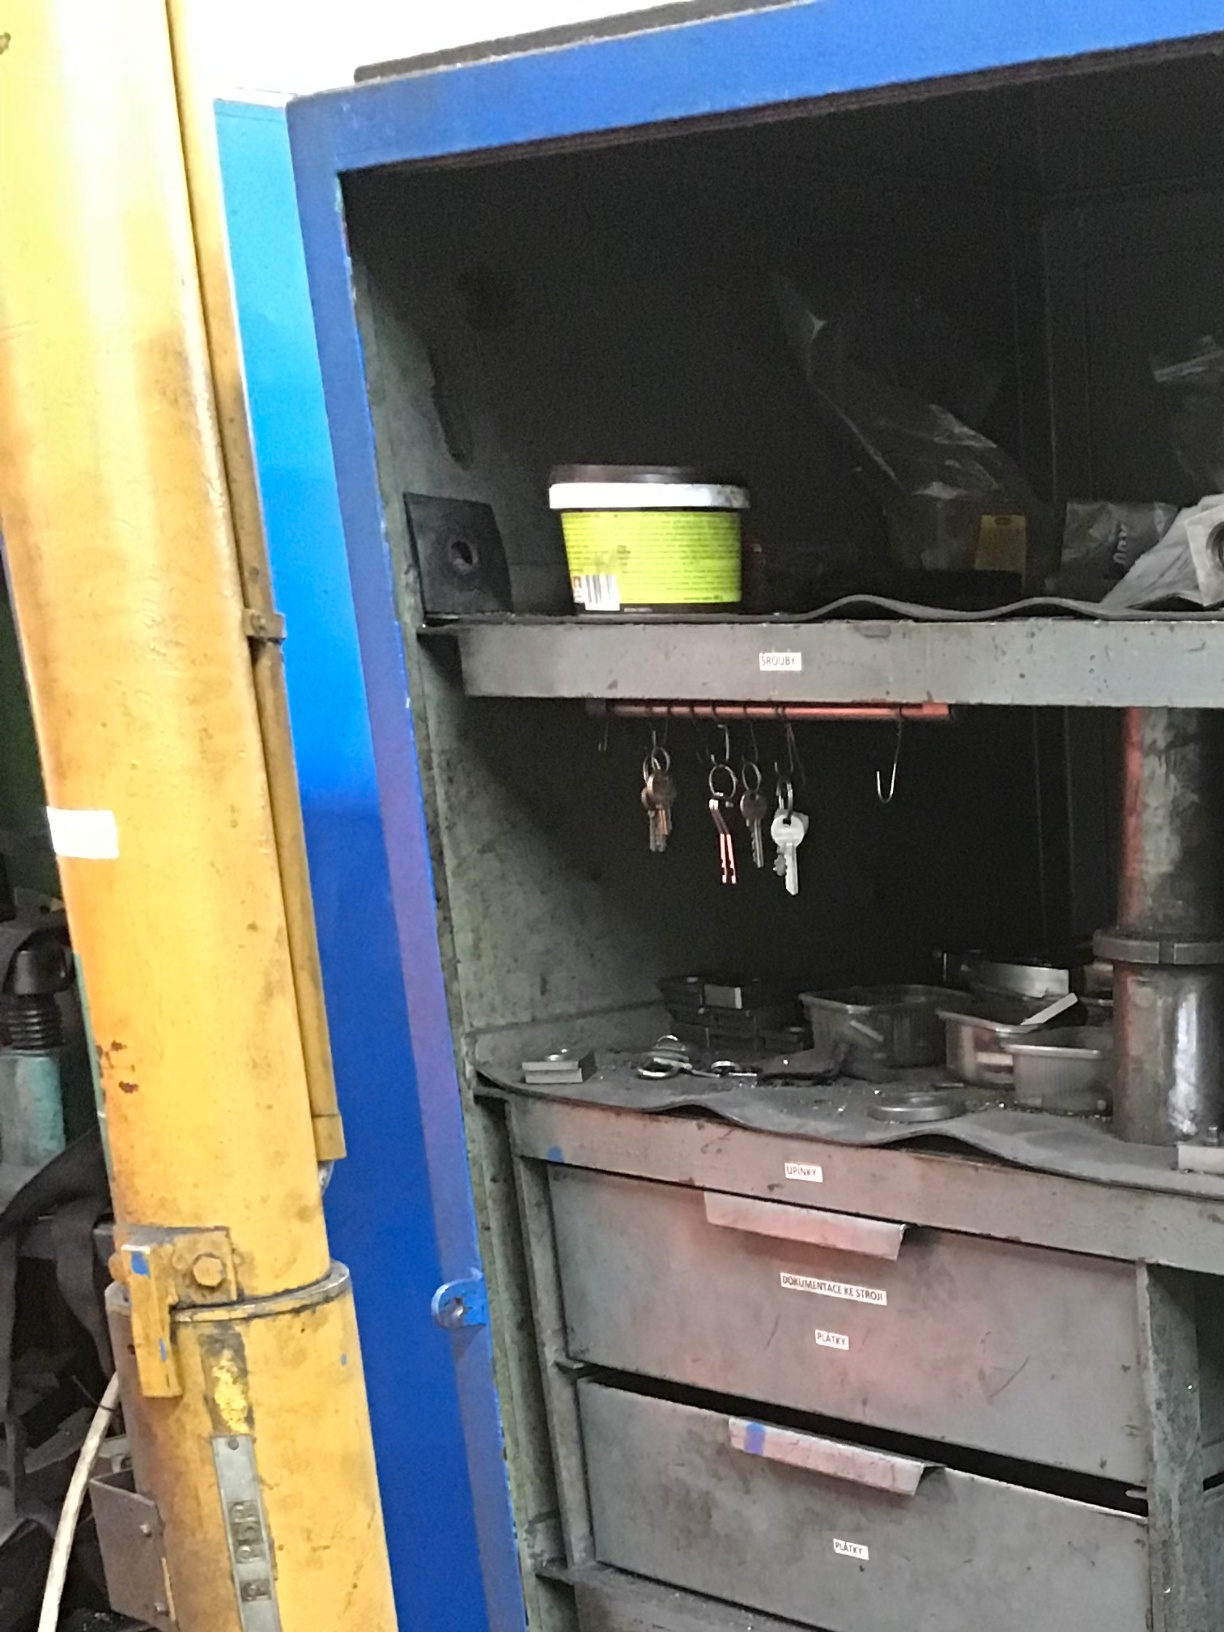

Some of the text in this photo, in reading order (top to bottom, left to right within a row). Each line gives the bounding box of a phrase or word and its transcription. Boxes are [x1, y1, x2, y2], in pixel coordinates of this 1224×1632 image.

[782, 1275, 883, 1301] DOKUMENTACE KE STROJI
